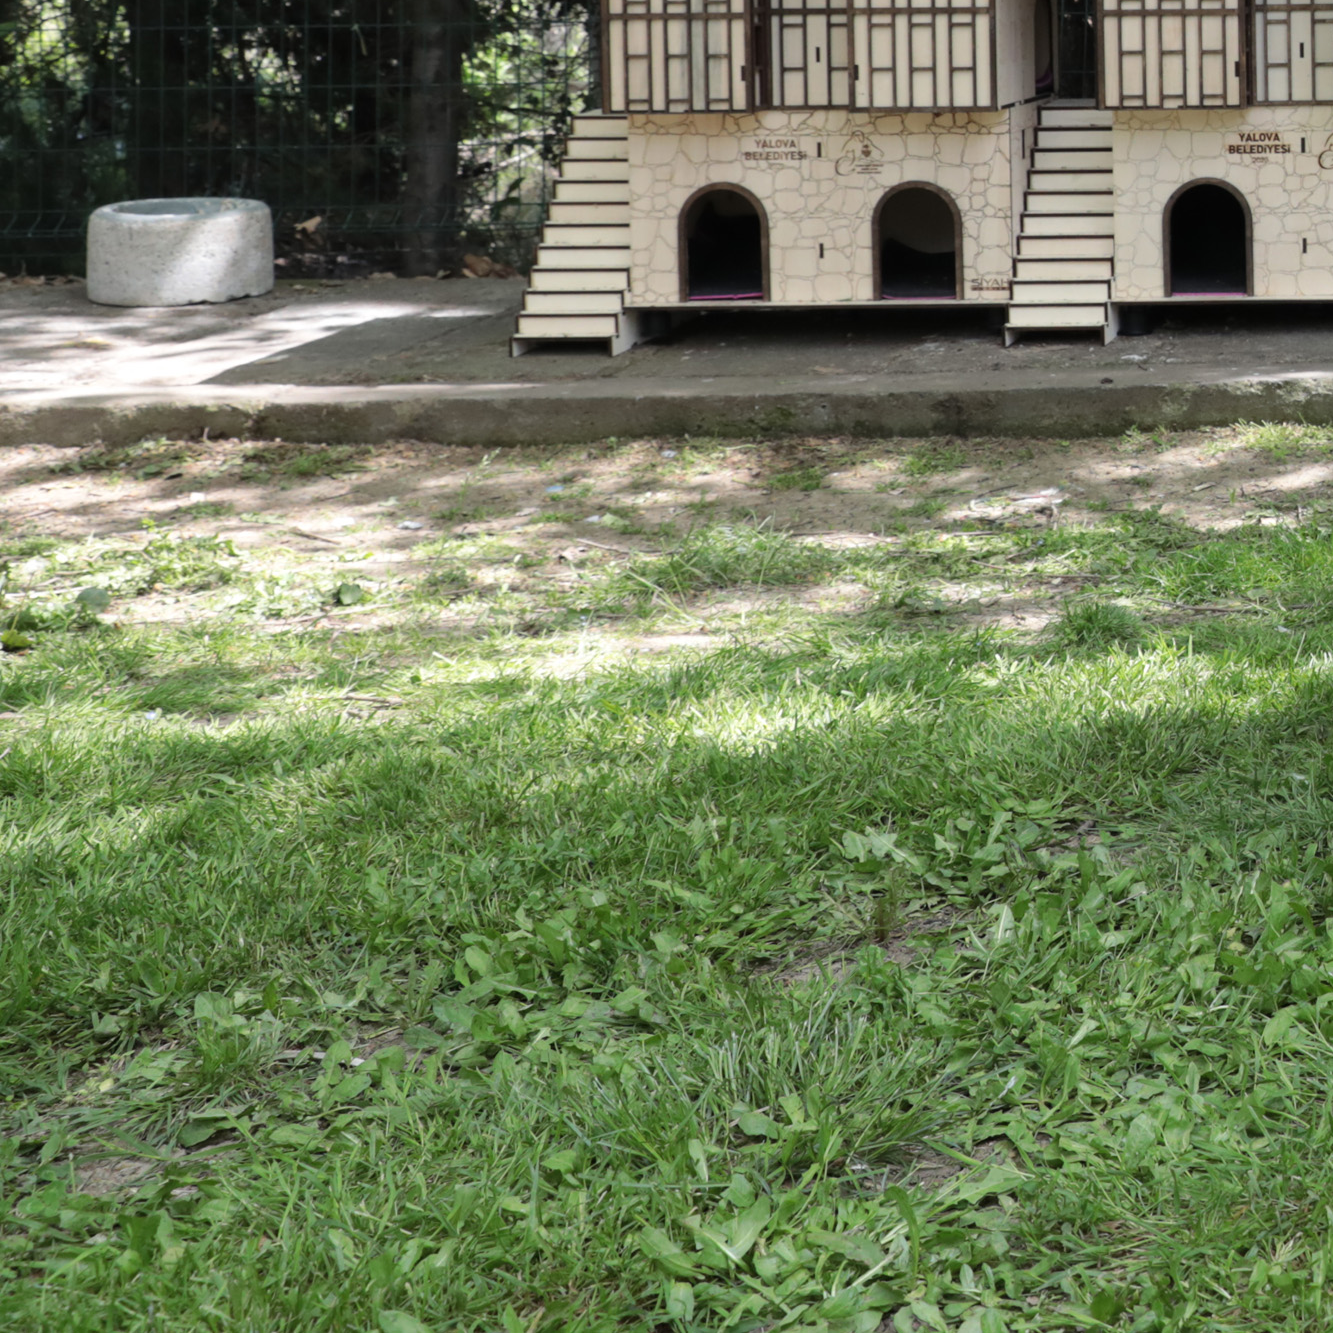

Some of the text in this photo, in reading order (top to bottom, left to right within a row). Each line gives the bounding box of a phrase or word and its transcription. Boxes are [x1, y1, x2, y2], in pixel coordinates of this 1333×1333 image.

[1239, 133, 1280, 142] YALOVA
[754, 139, 796, 148] YALOVA
[1228, 144, 1290, 154] BELEDİYESİ
